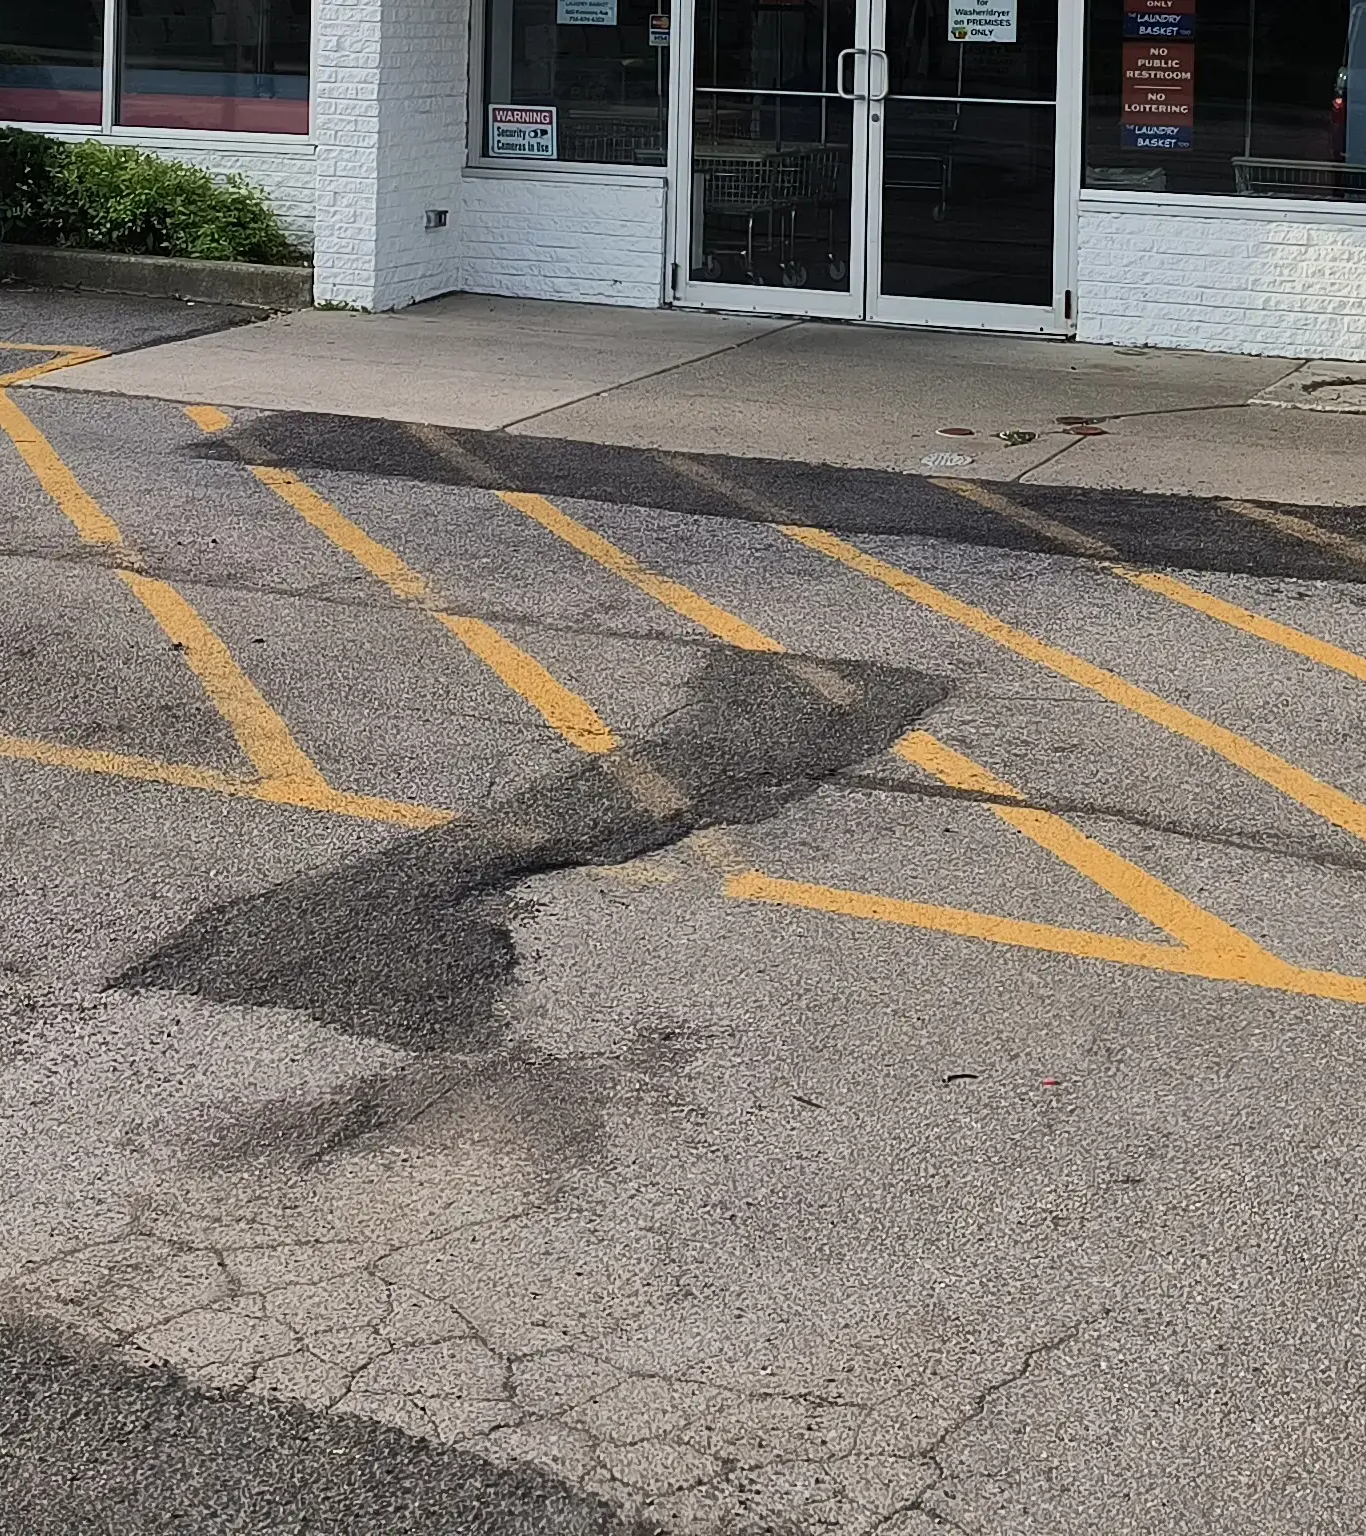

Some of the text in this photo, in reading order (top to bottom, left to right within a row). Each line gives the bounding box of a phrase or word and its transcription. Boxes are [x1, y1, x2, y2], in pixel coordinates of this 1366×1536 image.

[966, 18, 1012, 27] PREMISES
[1137, 14, 1181, 24] LAUNDRY
[970, 28, 995, 37] ONLY
[1138, 26, 1178, 36] BASKET
[1149, 47, 1168, 56] NO
[1137, 58, 1180, 68] PUBLIC
[1126, 70, 1191, 80] RESTROOM
[1147, 92, 1166, 101] NO
[1124, 103, 1189, 114] LOITERING
[495, 110, 550, 124] WARNING
[497, 126, 527, 141] Security
[1135, 125, 1179, 135] LAUNDRY
[497, 140, 526, 152] Cameras
[537, 141, 549, 153] Use
[1137, 137, 1177, 148] BASKET
